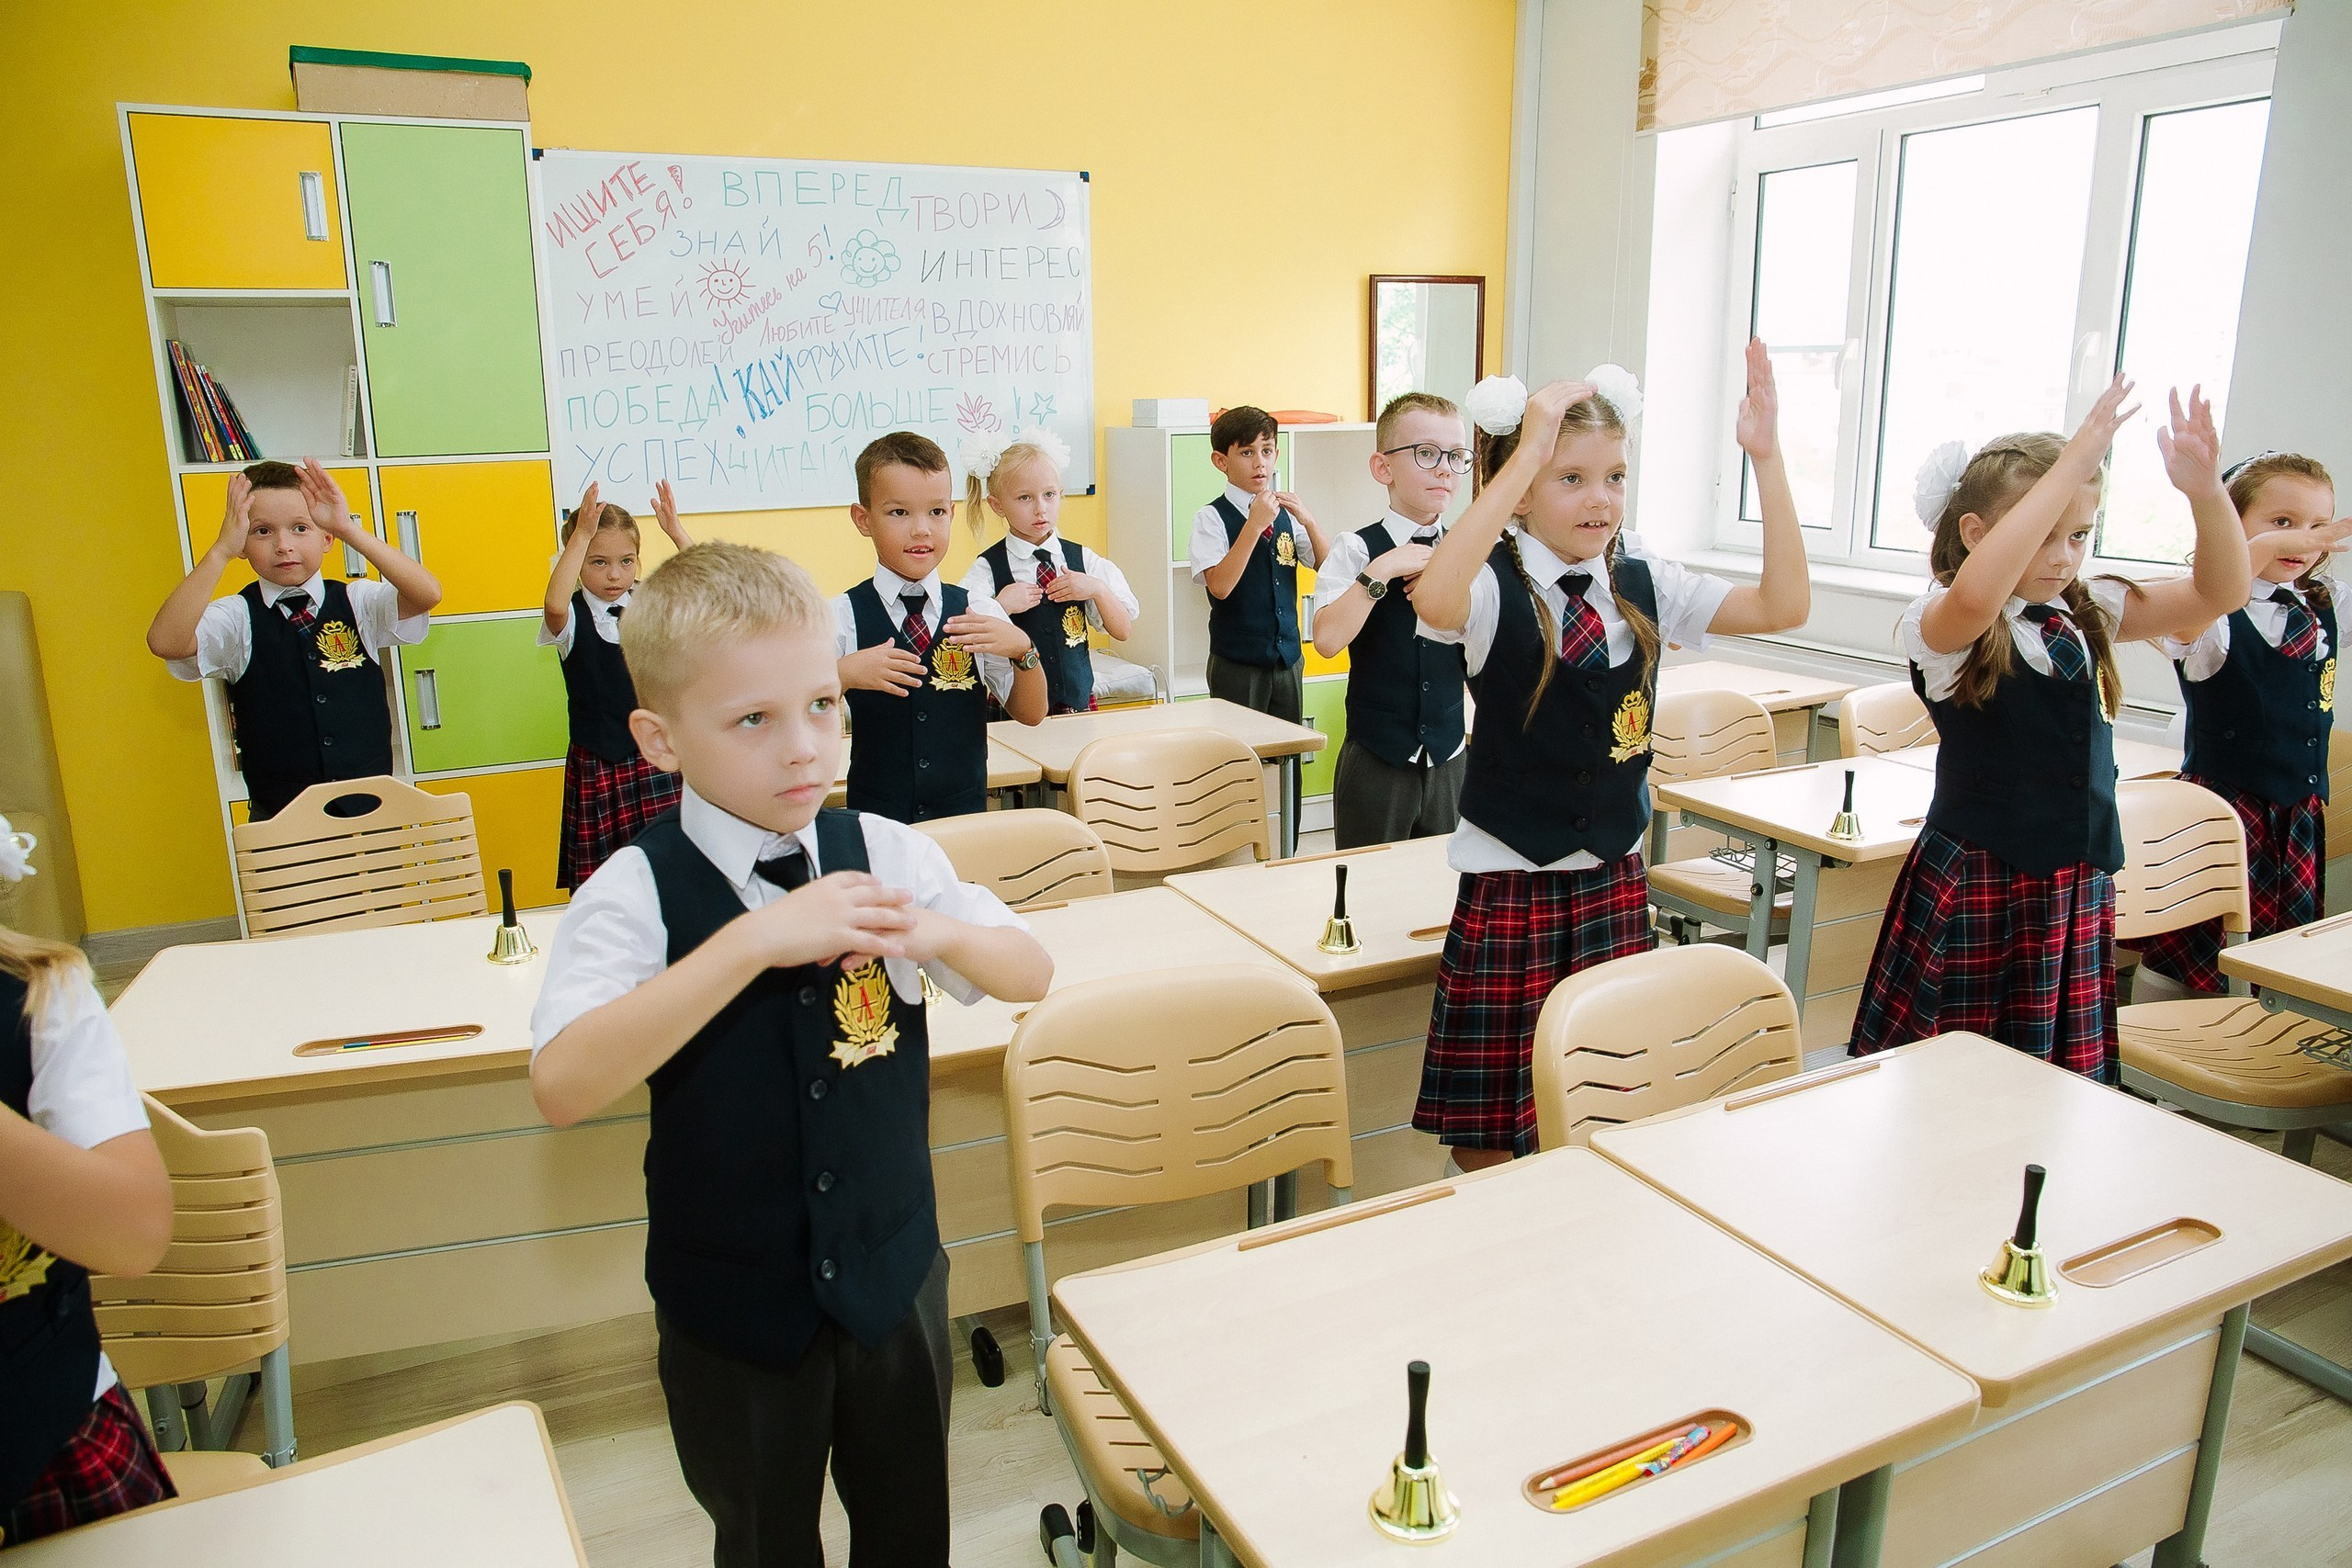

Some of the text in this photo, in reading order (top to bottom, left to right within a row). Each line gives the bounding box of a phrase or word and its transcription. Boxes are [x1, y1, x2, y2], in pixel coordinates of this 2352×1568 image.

[546, 161, 655, 248] ИЩИТЕ
[723, 171, 909, 227] ВПЕРЕД
[910, 192, 1031, 231] ТВОРИ
[670, 215, 781, 259] ЗНАЙ
[786, 267, 808, 291] на
[921, 246, 1080, 283] ИНТЕРЕС
[576, 274, 693, 324] УМЕЙ
[842, 295, 926, 327] УЧИТЕЛЯ
[560, 335, 734, 378] ПРЕОДОЛЕЙ
[927, 344, 1071, 378] СТРЕМИСЬ
[807, 387, 954, 433] БОЛЬШЕ
[575, 439, 730, 493] УСПЕХ
[728, 435, 857, 492] ЧИТАЙ
